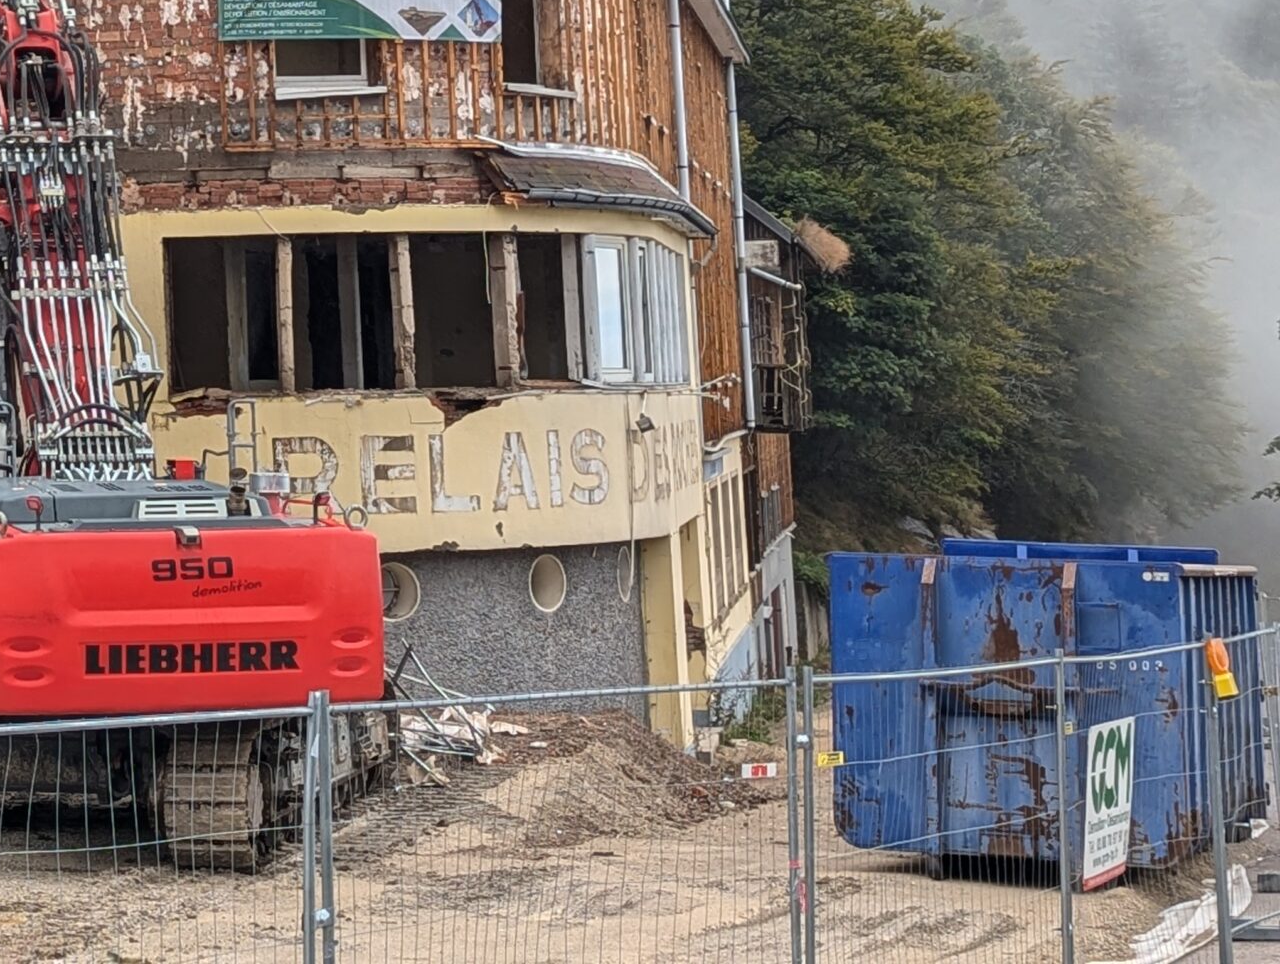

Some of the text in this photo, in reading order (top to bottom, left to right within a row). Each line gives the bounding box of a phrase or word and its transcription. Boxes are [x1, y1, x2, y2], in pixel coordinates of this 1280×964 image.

[271, 428, 610, 514] RELAIS
[152, 557, 233, 581] 950
[192, 579, 262, 598] demolition
[85, 640, 300, 675] LIEBHERR
[1091, 723, 1132, 814] GCM
